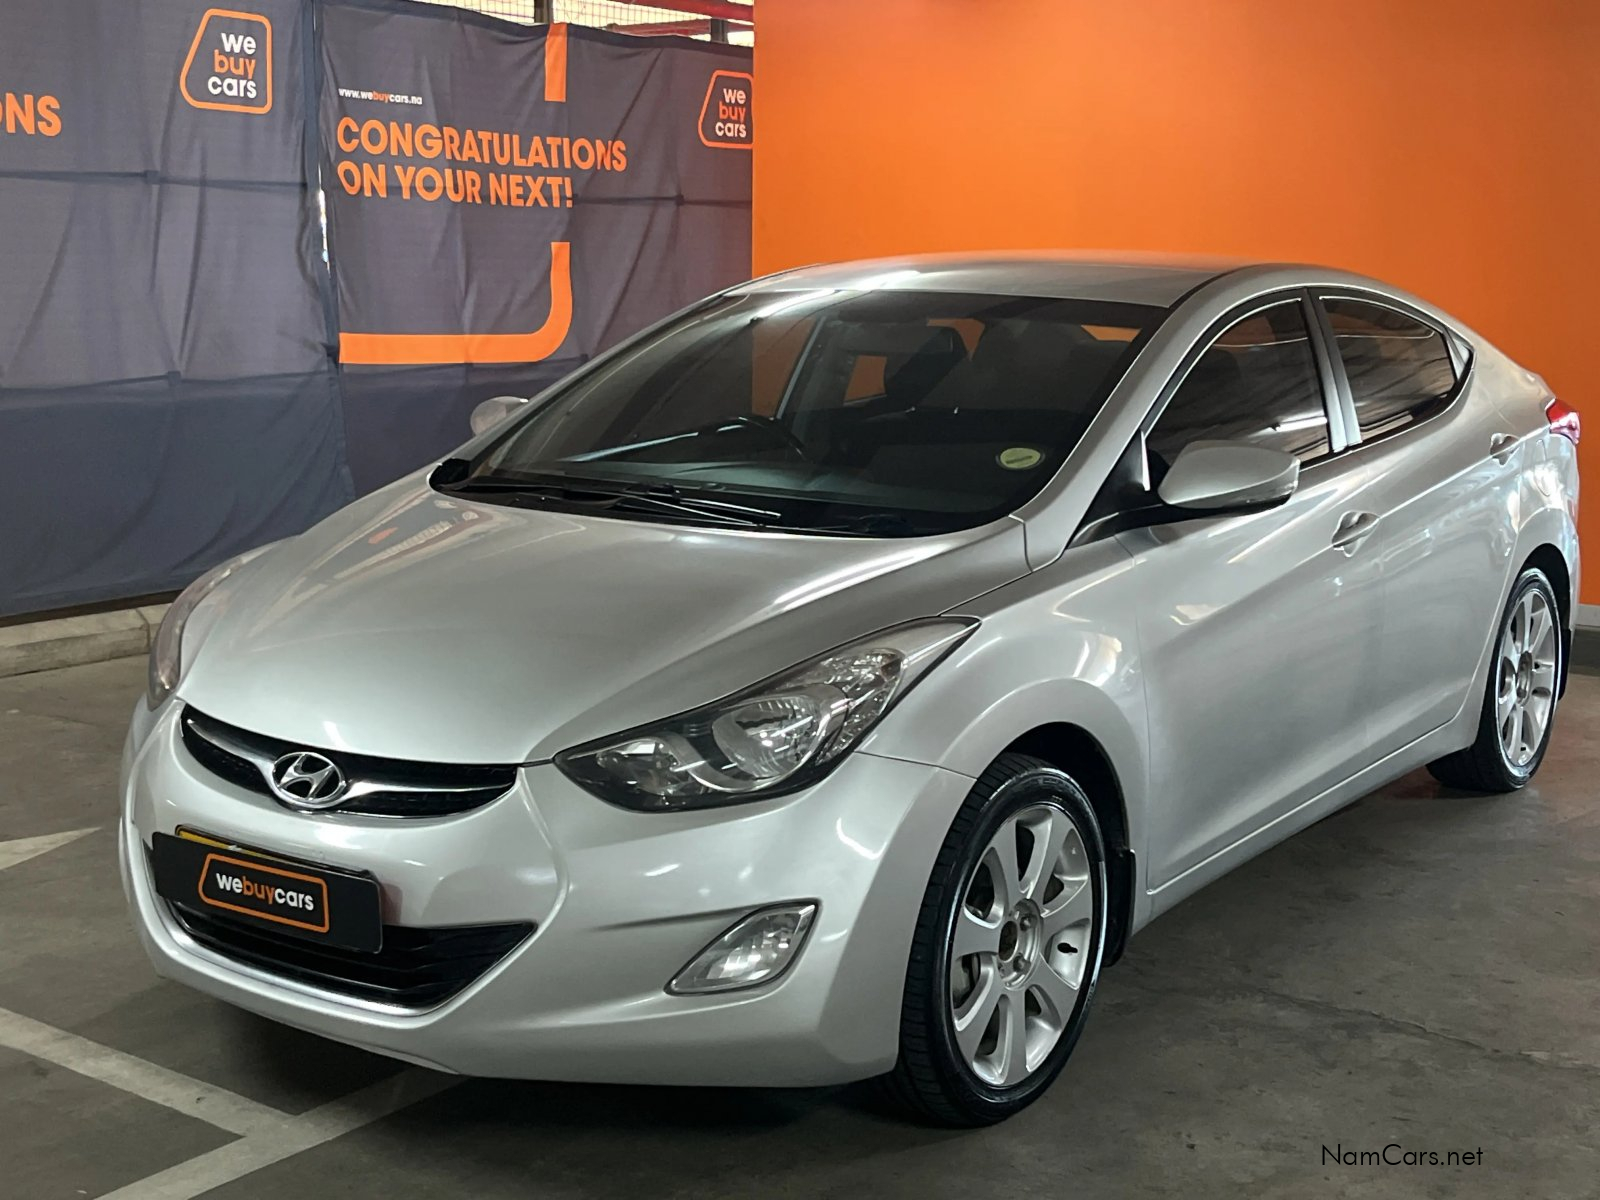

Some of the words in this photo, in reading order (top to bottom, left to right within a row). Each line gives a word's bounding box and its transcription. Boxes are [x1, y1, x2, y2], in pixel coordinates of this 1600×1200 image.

[221, 32, 257, 54] we
[214, 49, 256, 79] buy
[207, 76, 257, 99] cars
[338, 88, 423, 105] www.webuycars.na
[723, 87, 747, 104] we
[0, 92, 62, 137] NS
[718, 101, 746, 123] buy
[715, 121, 747, 138] cars
[336, 116, 627, 172] CONGRATULATIONS
[337, 160, 387, 198] ON
[394, 165, 482, 204] YOUR
[489, 173, 573, 208] NEXT!
[215, 872, 315, 911] webuycars
